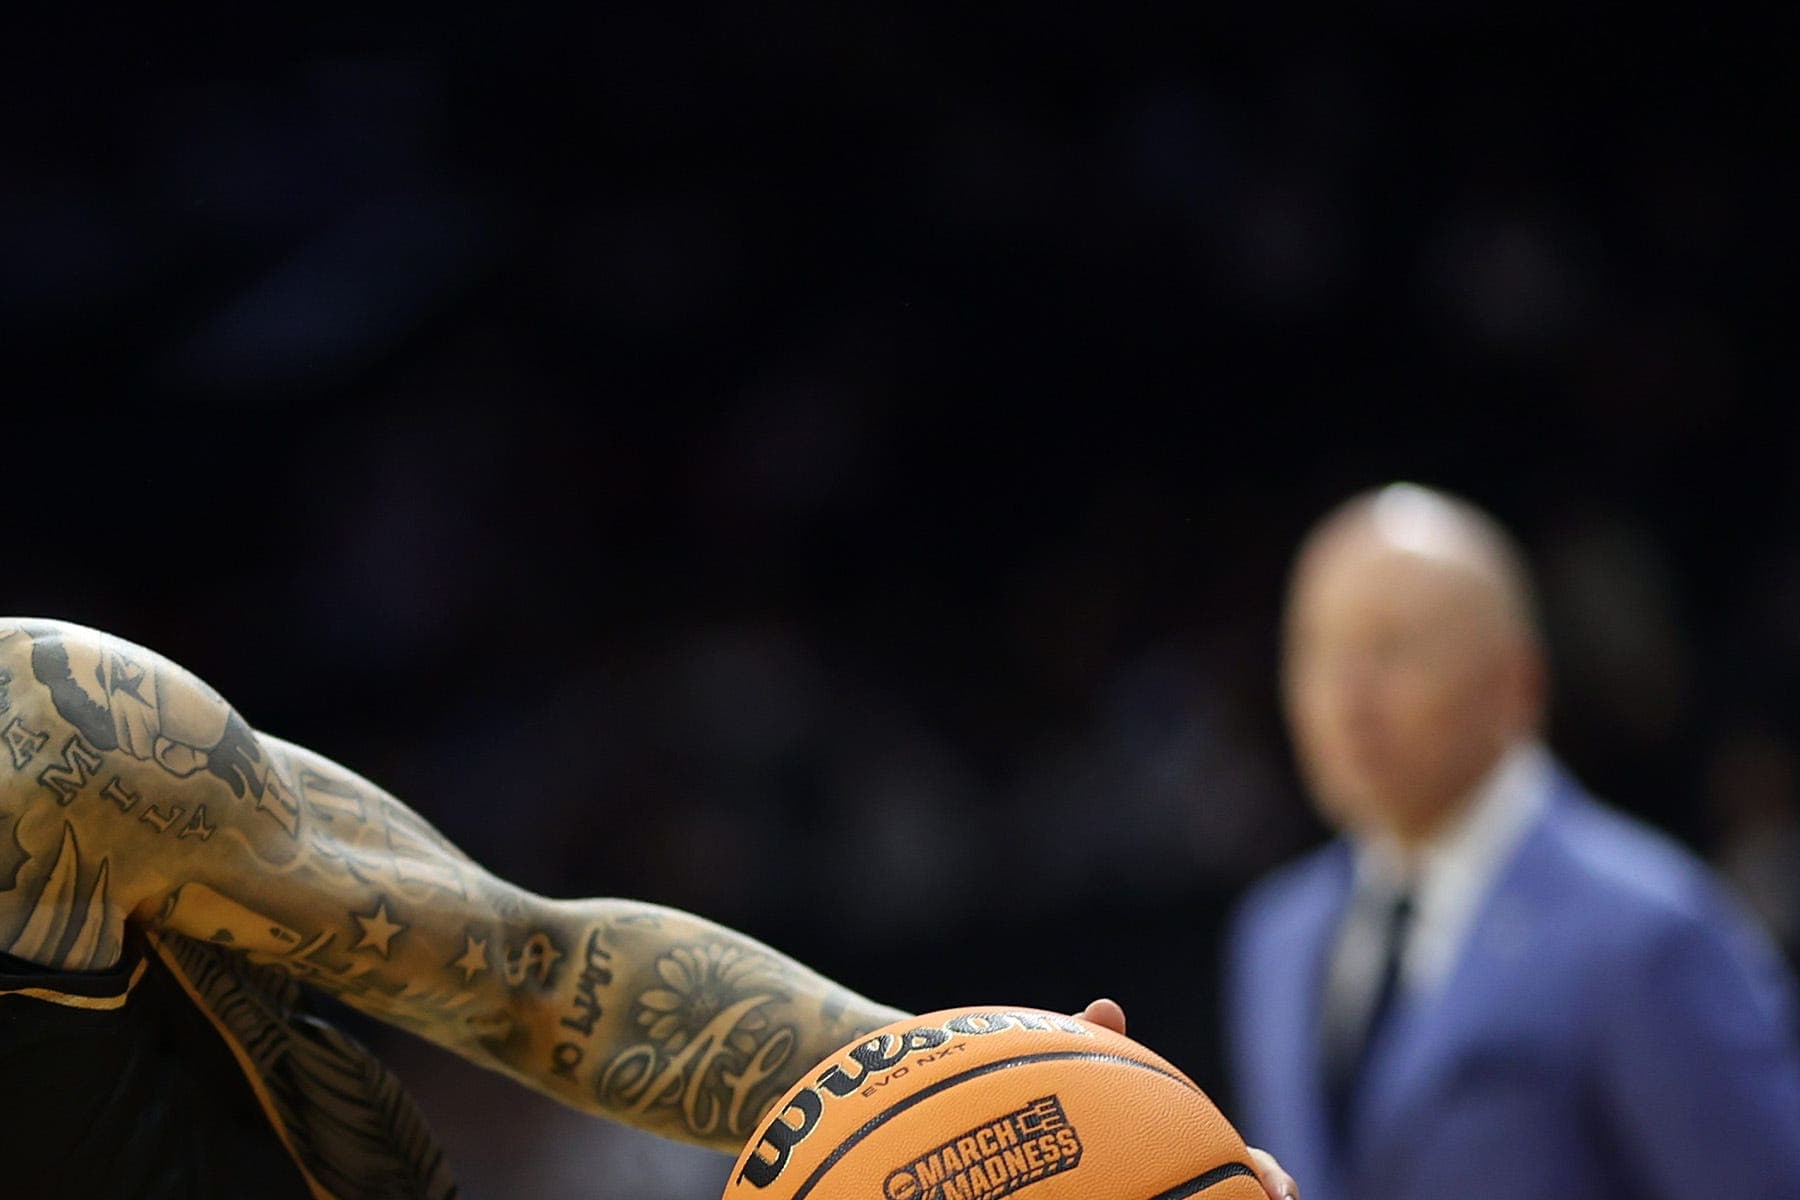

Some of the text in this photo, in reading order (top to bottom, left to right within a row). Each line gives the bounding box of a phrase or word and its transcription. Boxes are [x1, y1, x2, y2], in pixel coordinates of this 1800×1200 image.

[736, 1012, 1095, 1189] Wilson
[862, 1041, 968, 1098] EVO NXT
[914, 1119, 1018, 1191] MARCH
